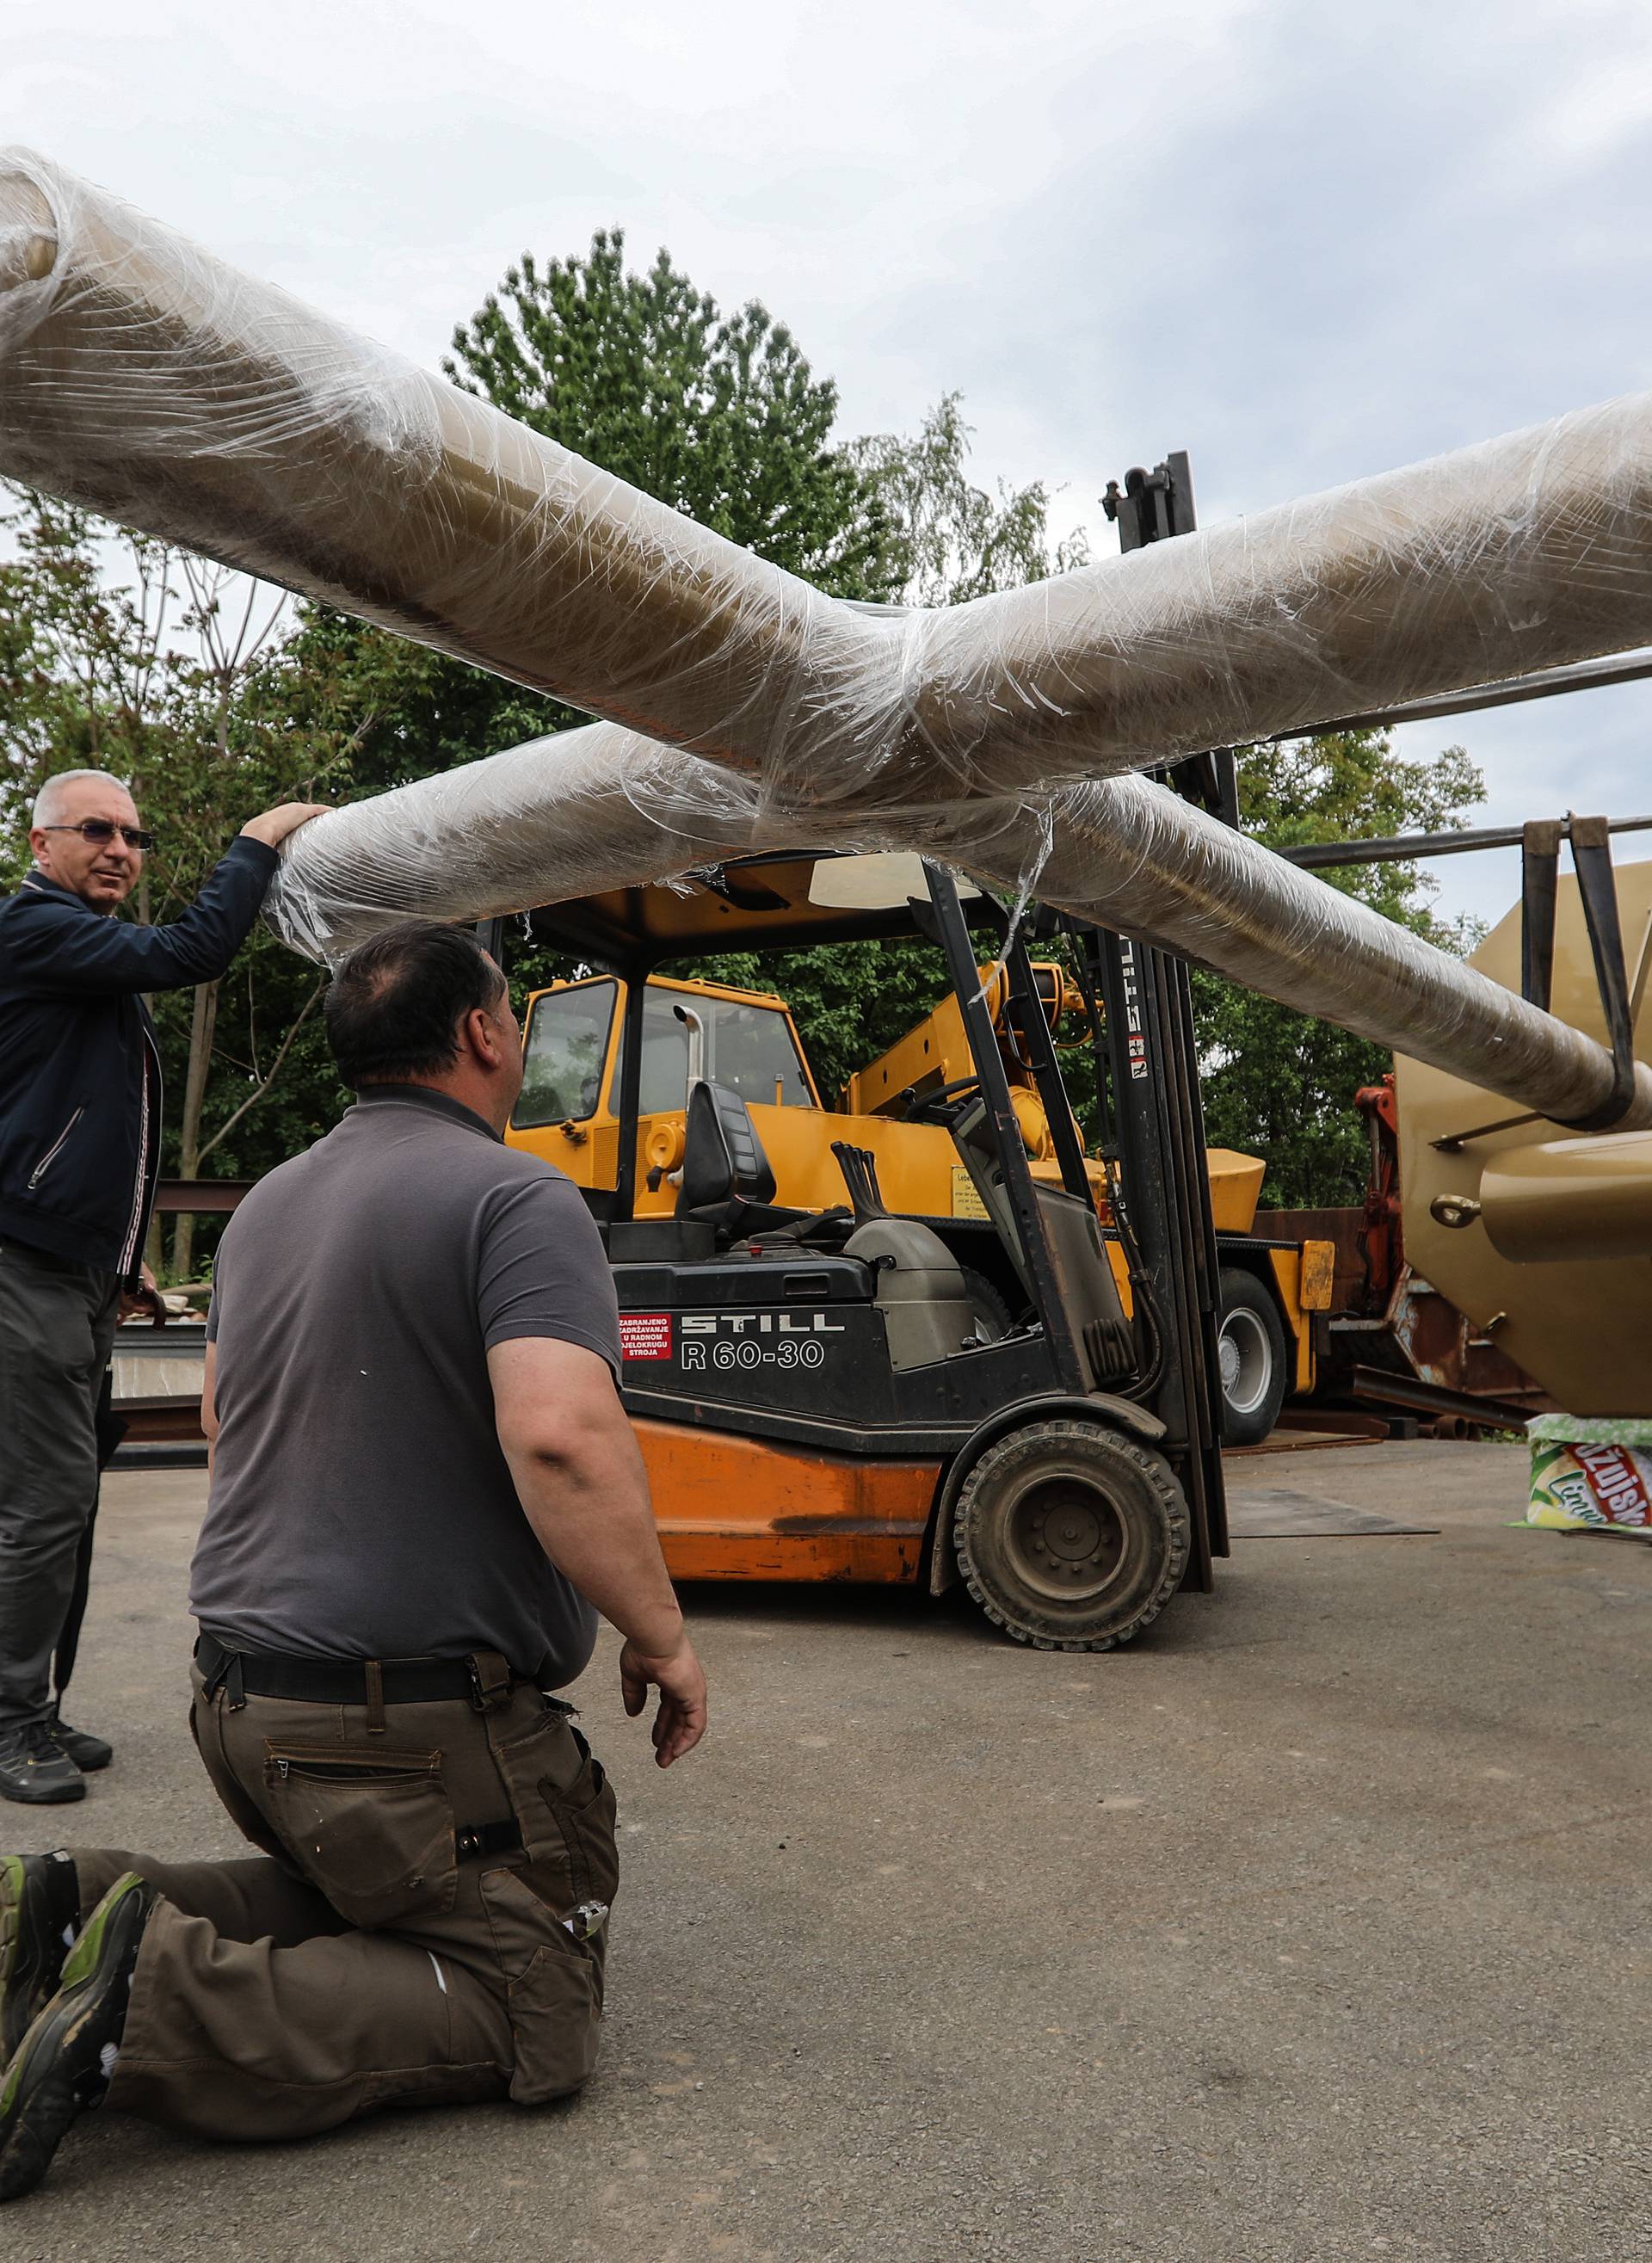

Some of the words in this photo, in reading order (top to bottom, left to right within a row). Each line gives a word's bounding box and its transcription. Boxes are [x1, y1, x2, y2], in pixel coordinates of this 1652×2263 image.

[1119, 934, 1142, 1033] STIL
[681, 1314, 845, 1334] STILL
[681, 1341, 706, 1370] R
[712, 1340, 824, 1370] 60-30
